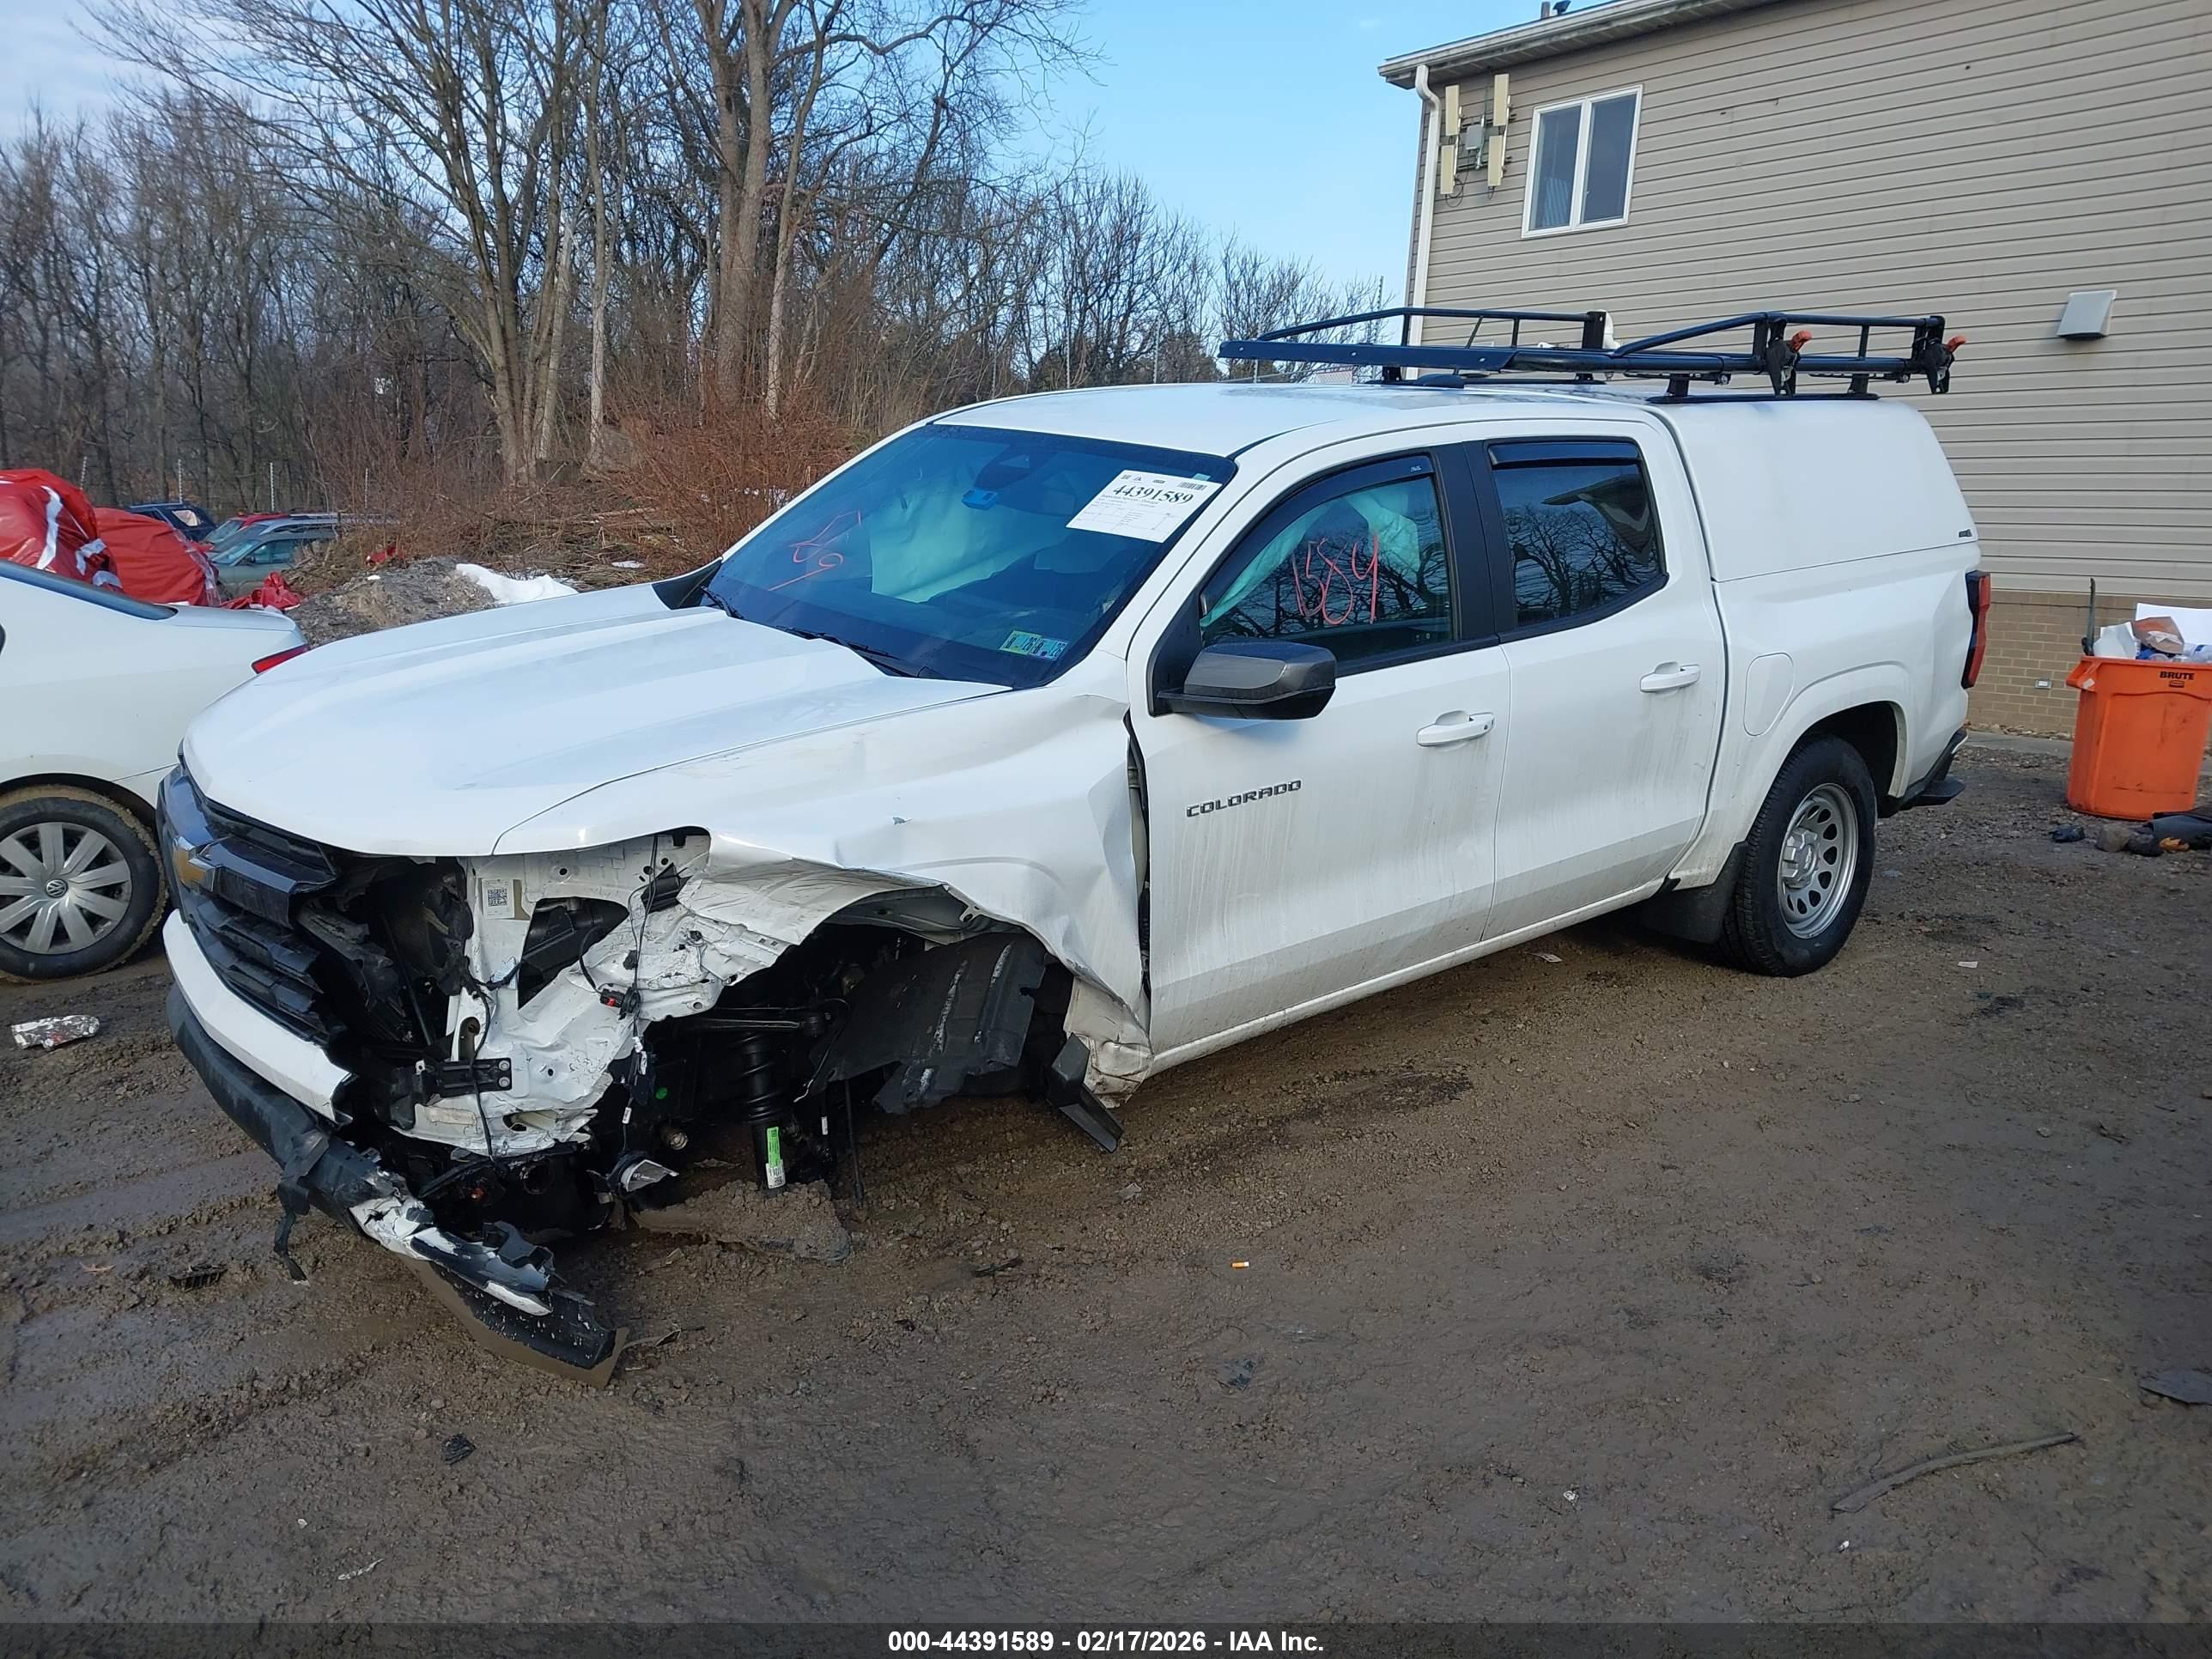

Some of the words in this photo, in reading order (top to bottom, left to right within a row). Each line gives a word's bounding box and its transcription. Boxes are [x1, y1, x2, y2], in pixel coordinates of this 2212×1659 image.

[1113, 484, 1194, 505] 44391589
[2160, 671, 2195, 680] BRUTE
[1186, 780, 1302, 817] COLORADO
